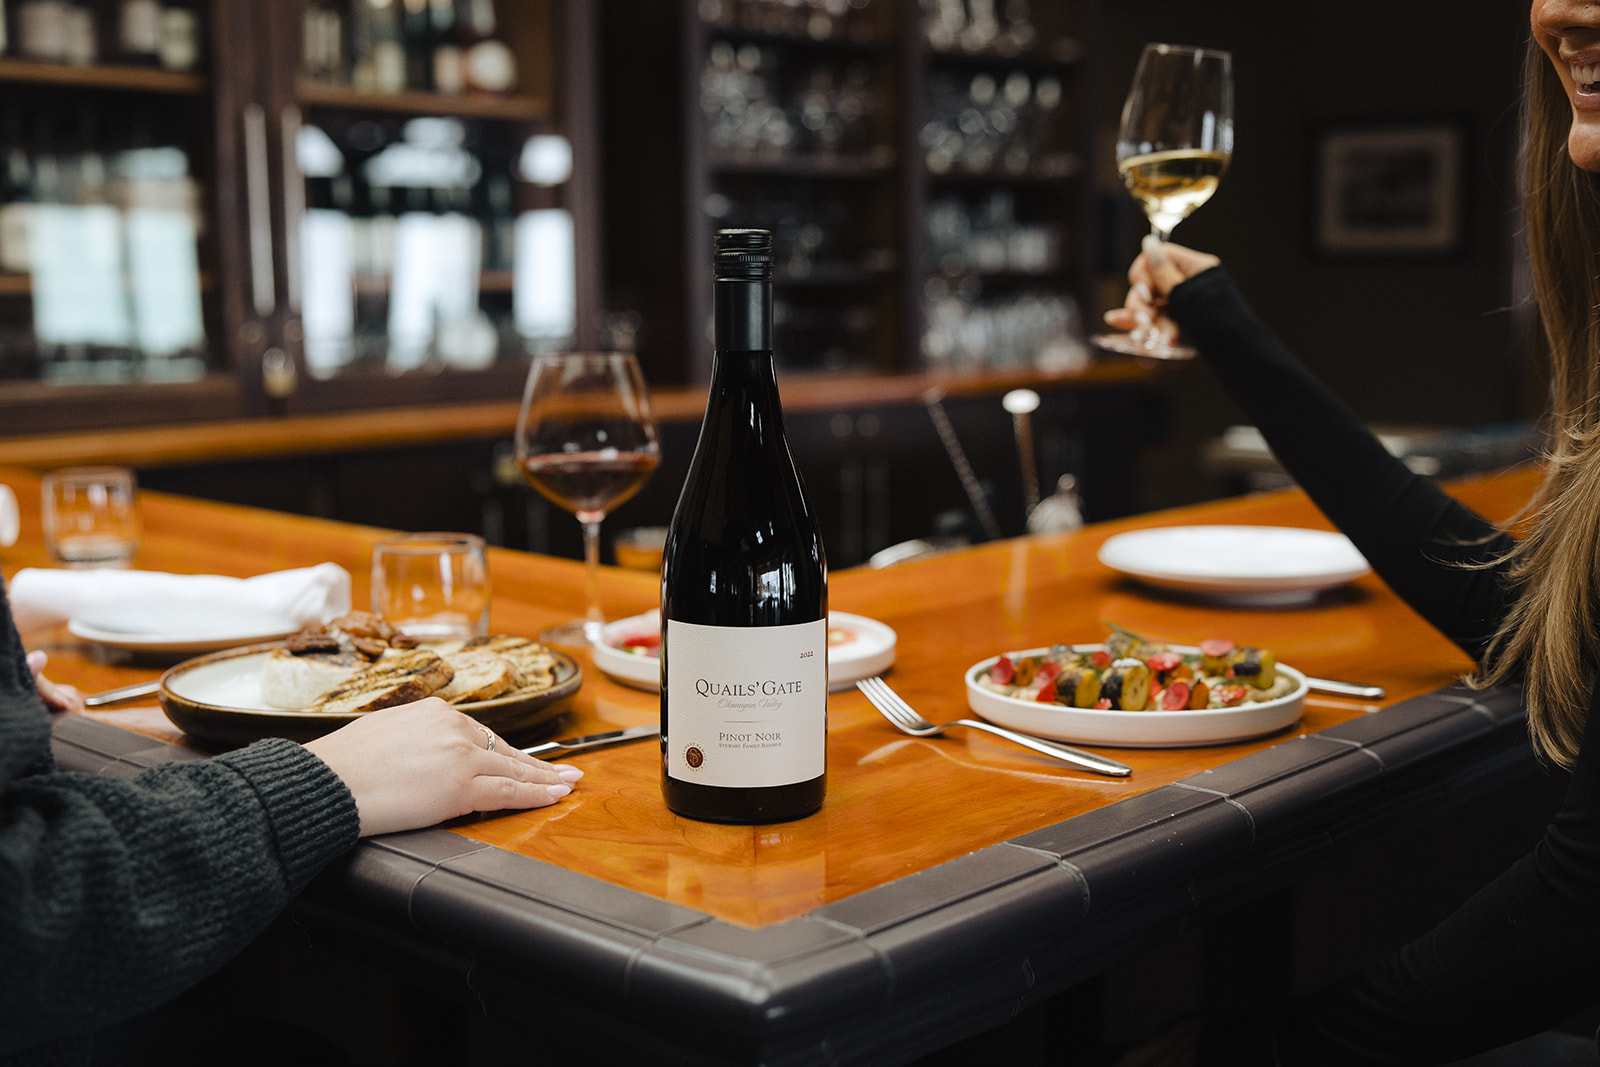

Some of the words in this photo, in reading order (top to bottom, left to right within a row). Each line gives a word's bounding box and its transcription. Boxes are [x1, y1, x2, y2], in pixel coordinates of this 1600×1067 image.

[800, 651, 814, 659] 2022
[762, 680, 802, 696] GATE
[758, 698, 782, 712] Valley
[719, 732, 752, 742] PINOT
[755, 732, 782, 741] NOIR
